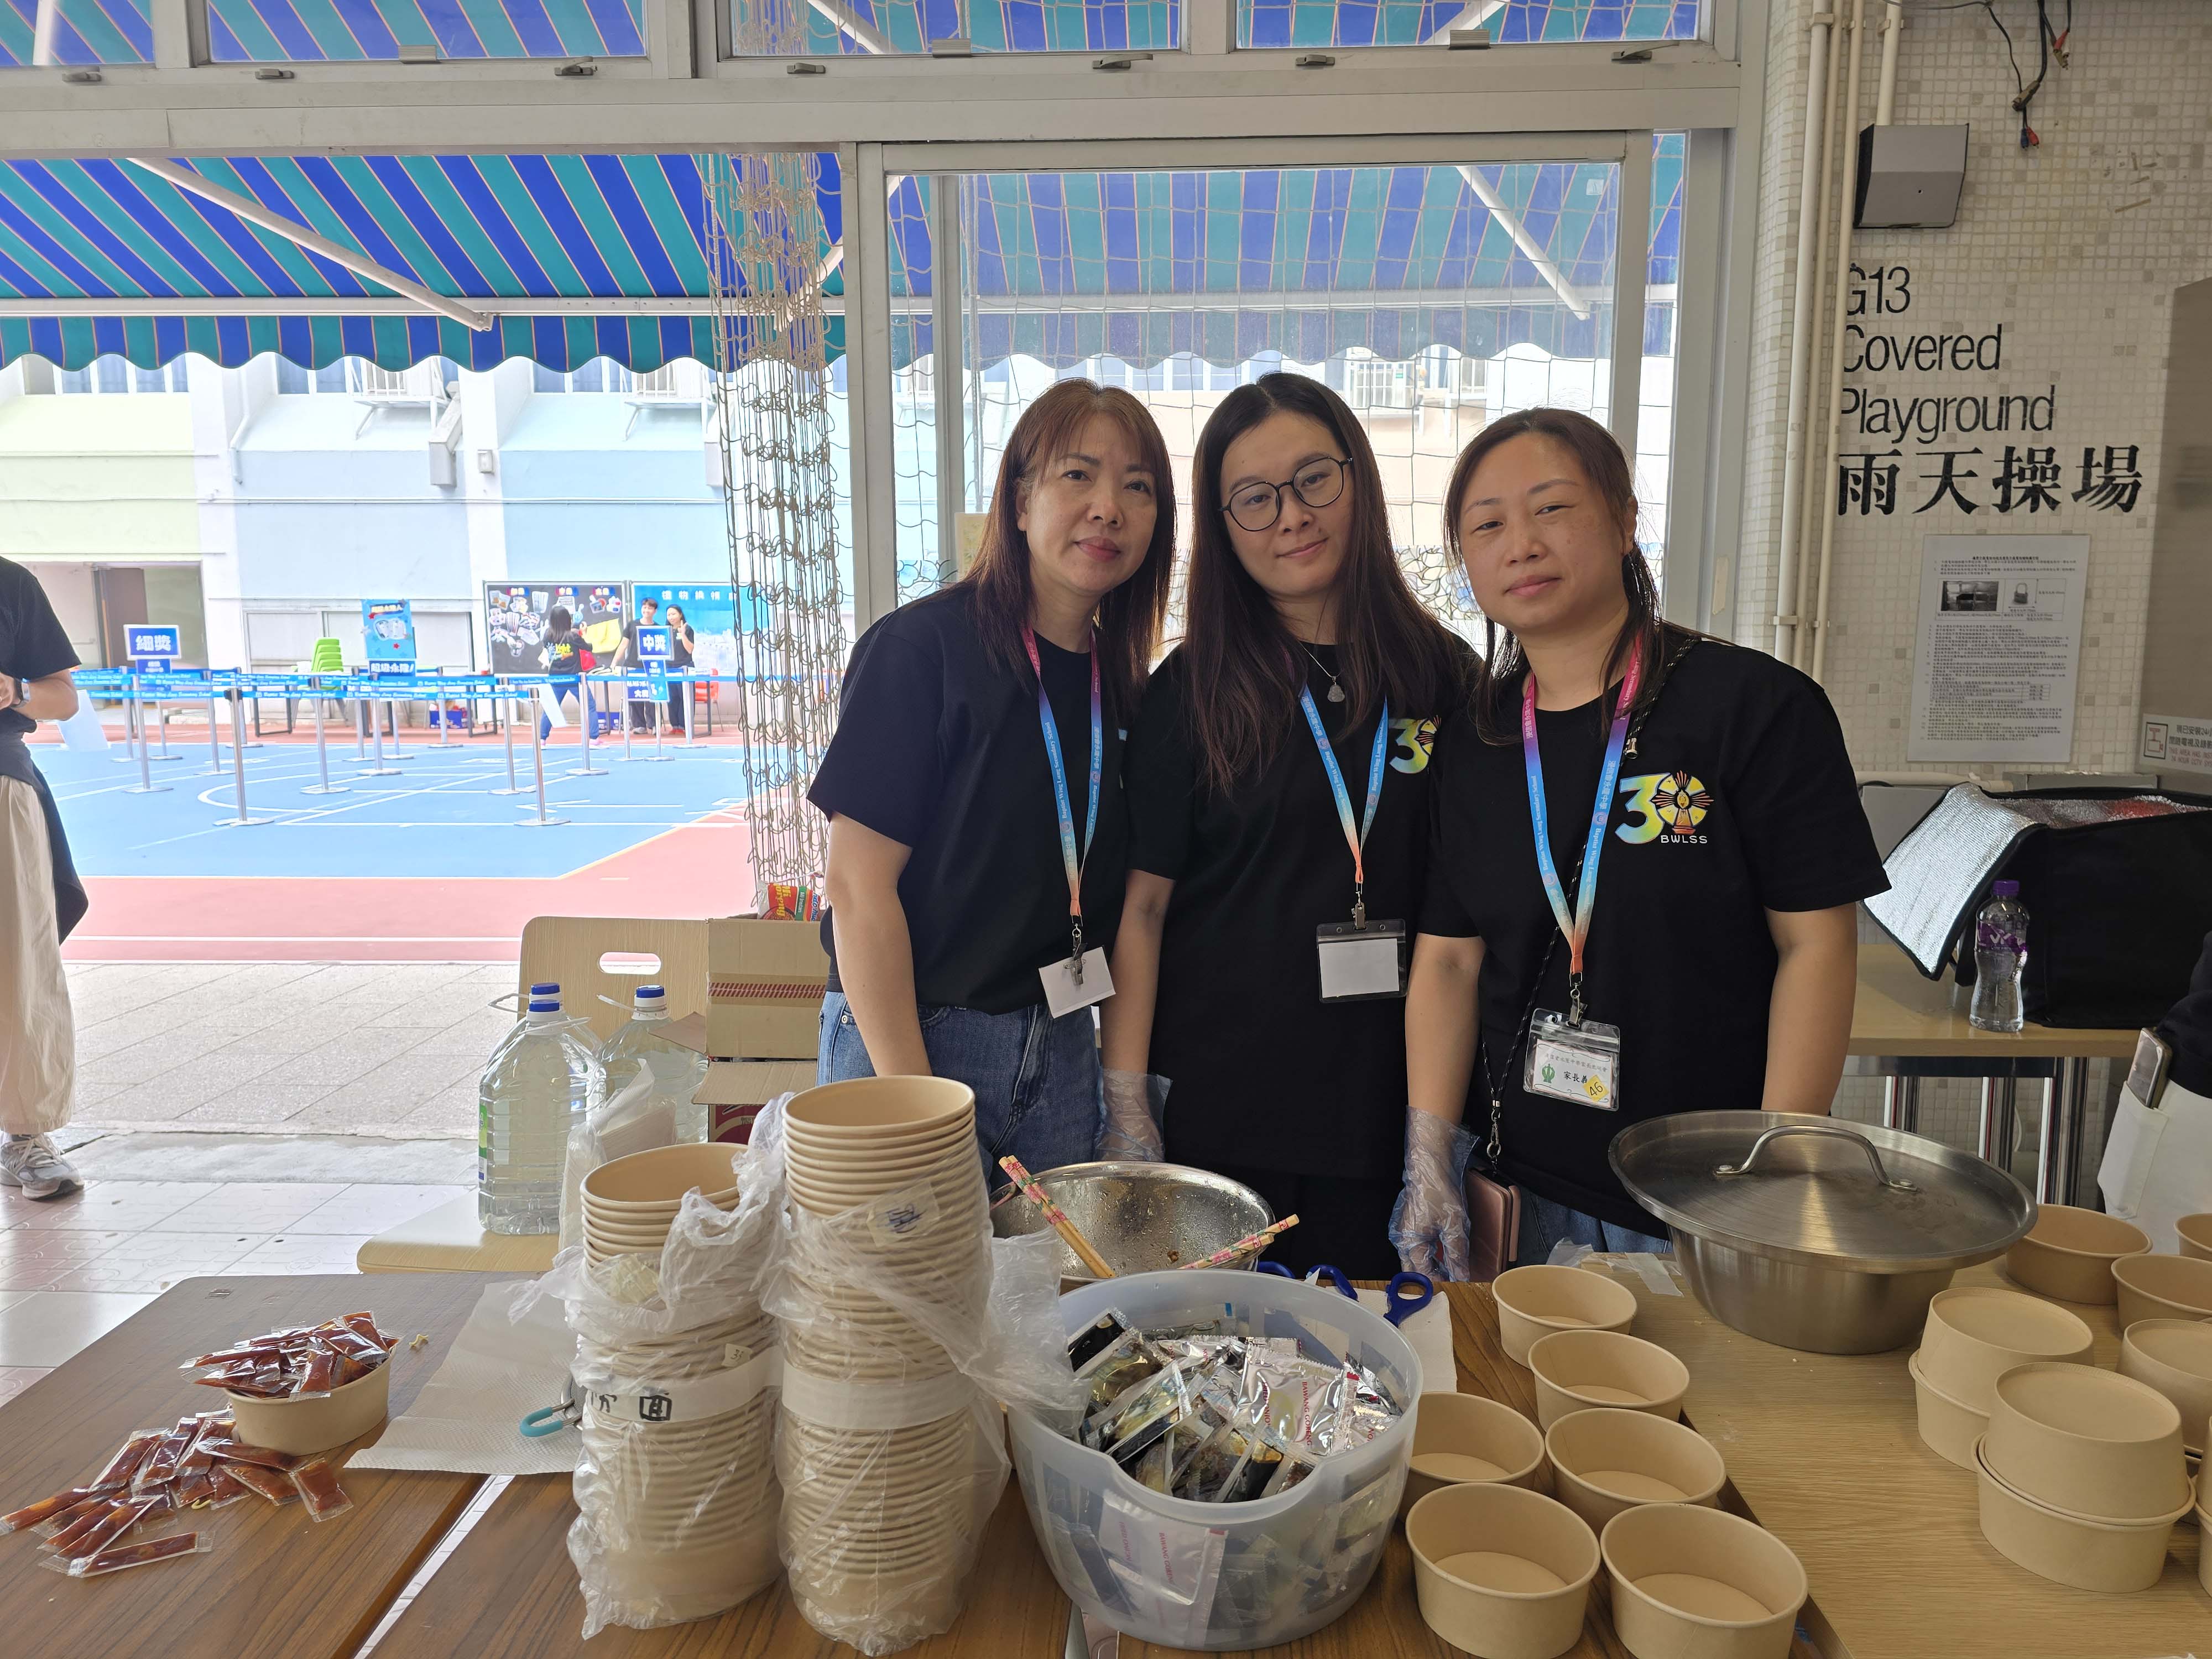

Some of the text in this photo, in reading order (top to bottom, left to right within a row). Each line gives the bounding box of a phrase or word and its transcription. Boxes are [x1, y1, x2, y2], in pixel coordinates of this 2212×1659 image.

[1846, 265, 1911, 316] G13
[1844, 324, 2003, 373] Covered
[1841, 384, 2057, 444] Playground
[1838, 444, 2142, 515] 雨天操場
[1660, 834, 1708, 844] BWLSS
[1589, 1081, 1604, 1097] 46
[1302, 1381, 1310, 1413] BAWANG
